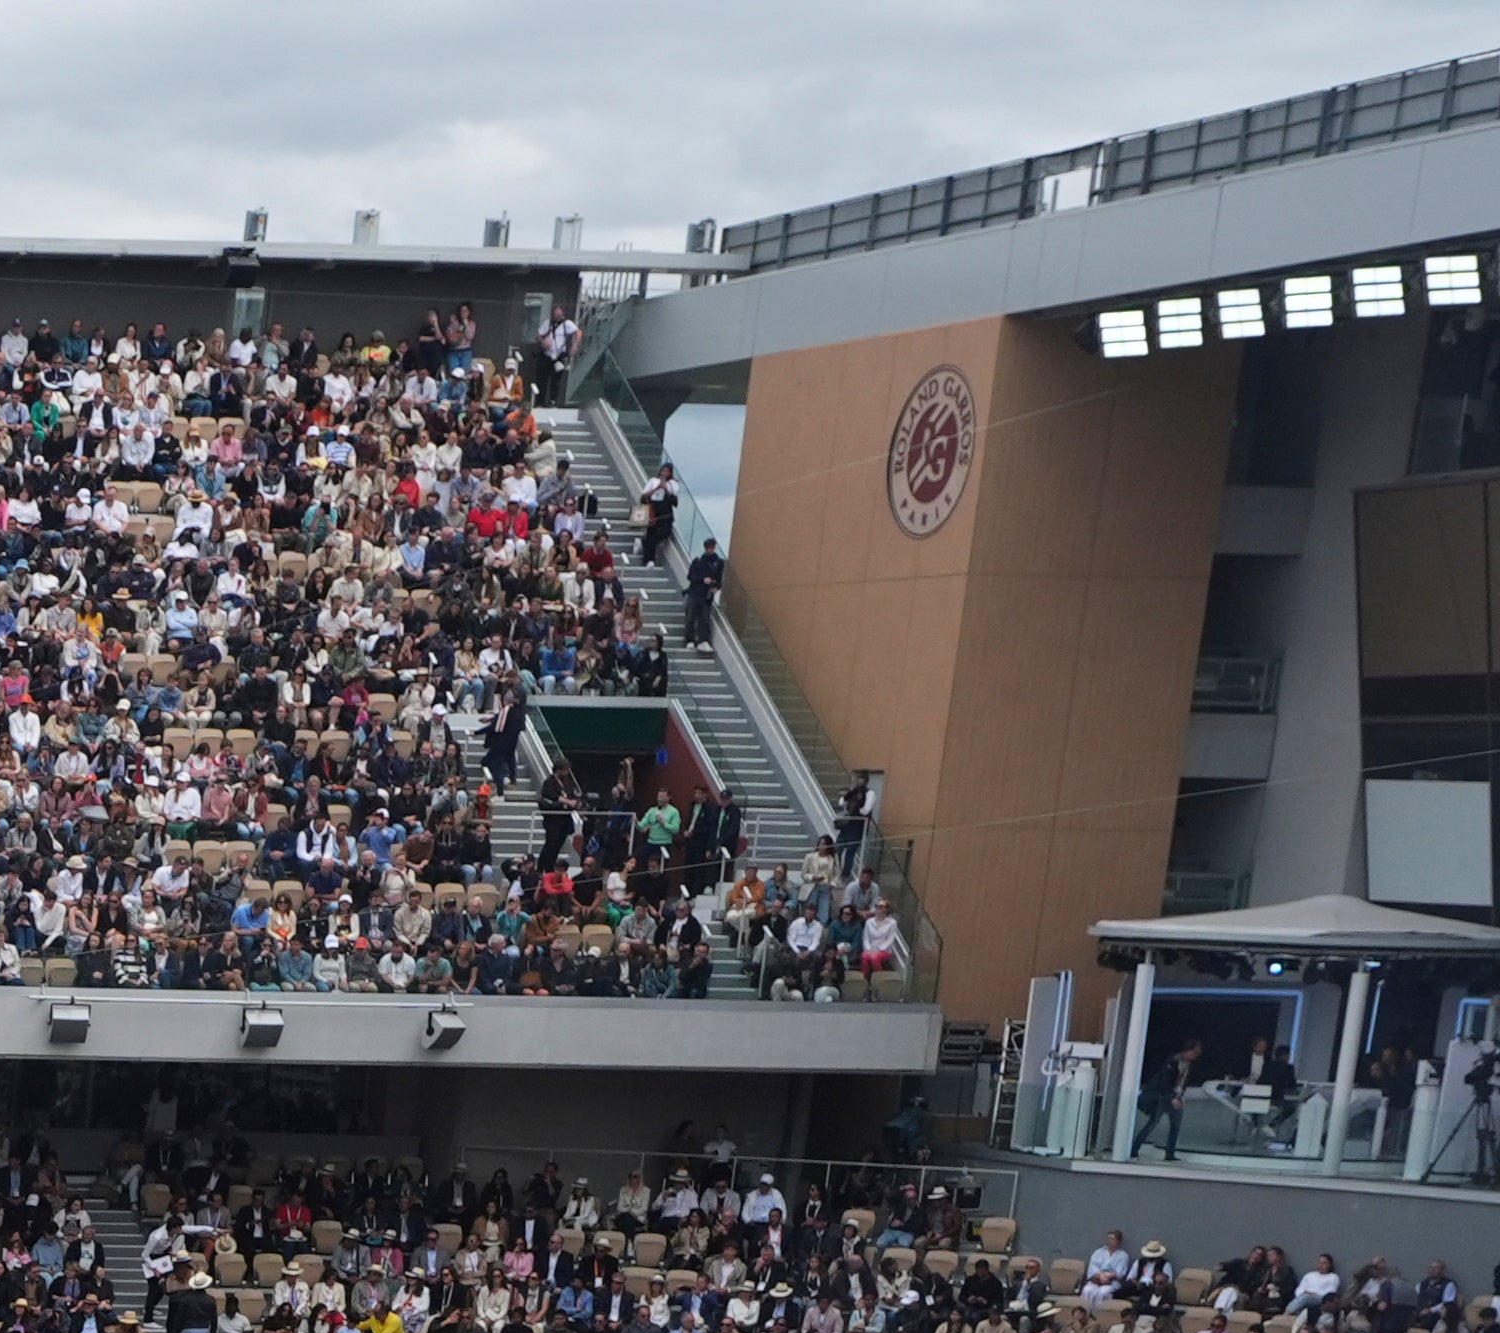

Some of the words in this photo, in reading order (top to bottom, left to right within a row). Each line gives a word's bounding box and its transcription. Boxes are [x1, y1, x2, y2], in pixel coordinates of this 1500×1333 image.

[894, 378, 940, 475] ROLAND
[943, 375, 973, 466] GARROS
[900, 492, 952, 527] PARIS
